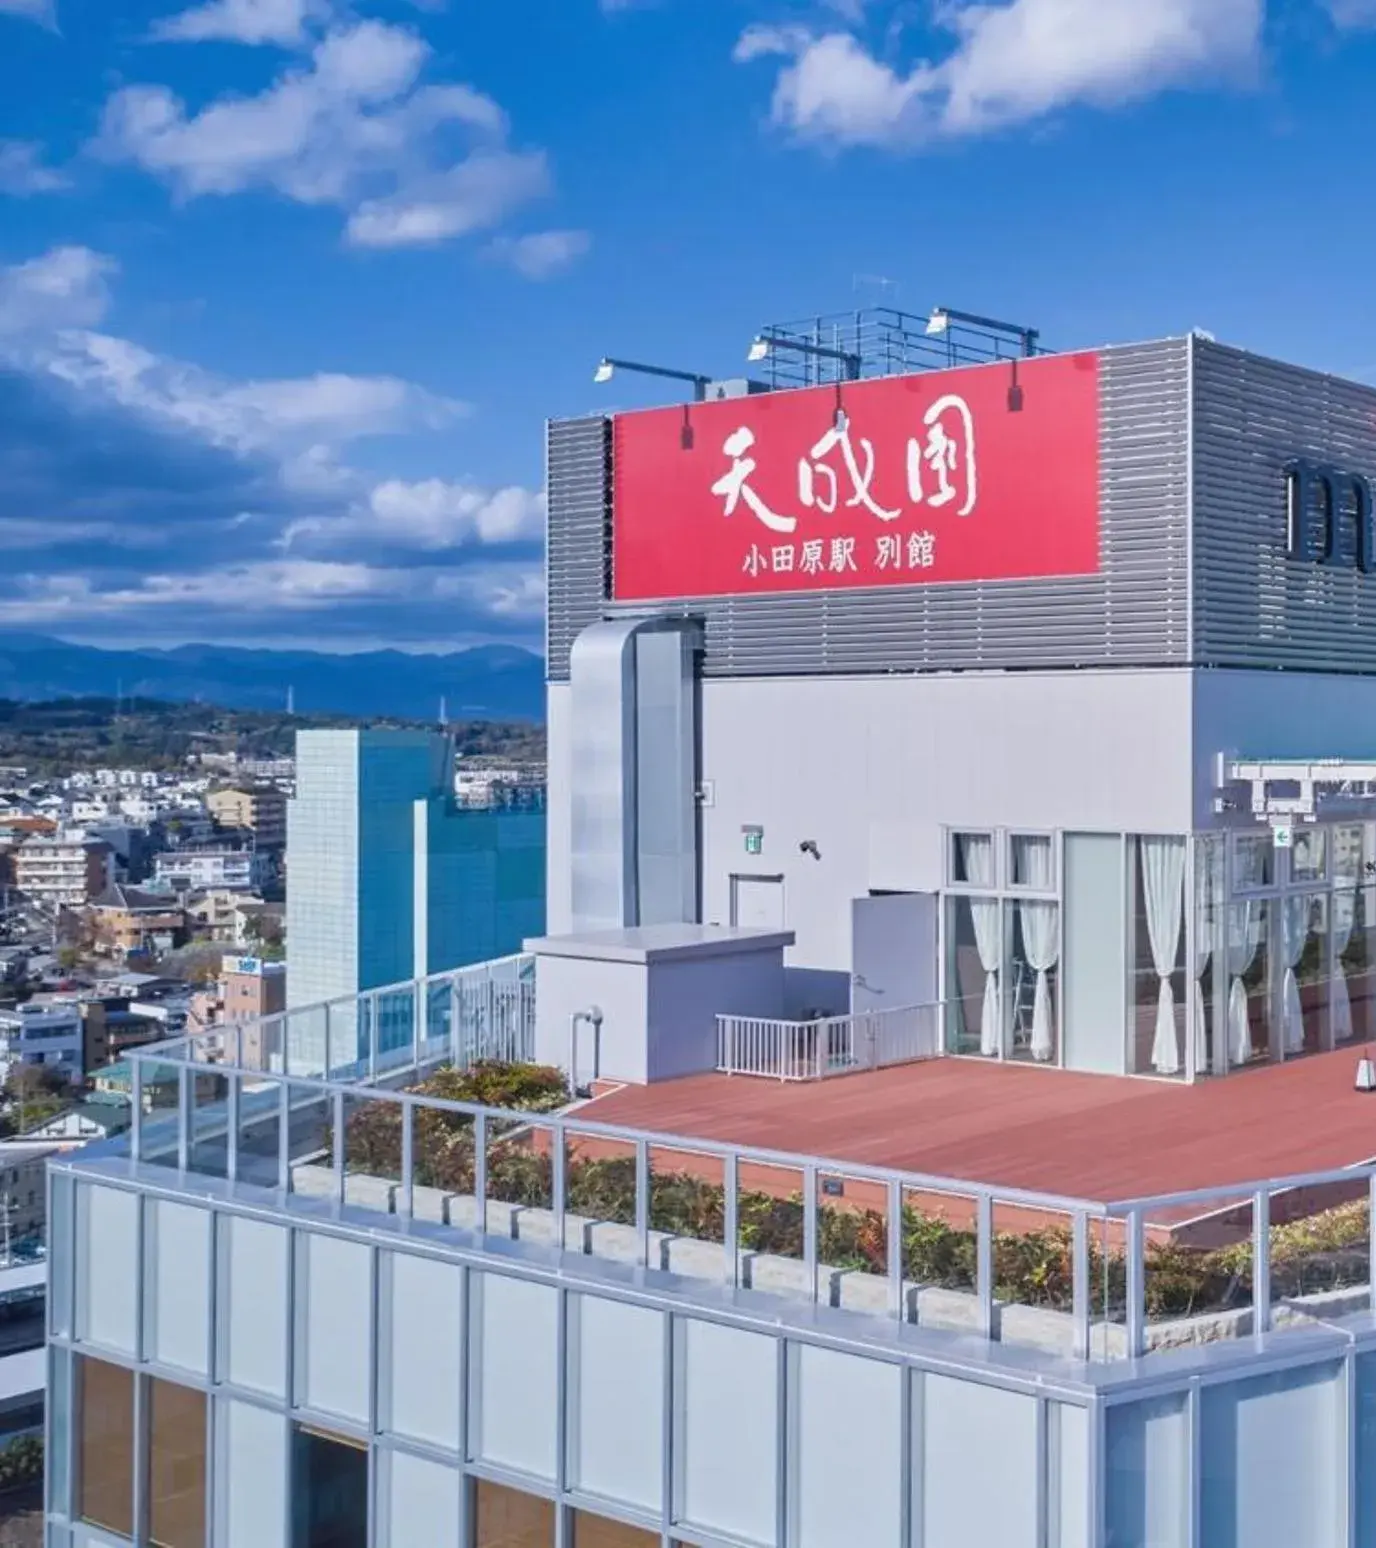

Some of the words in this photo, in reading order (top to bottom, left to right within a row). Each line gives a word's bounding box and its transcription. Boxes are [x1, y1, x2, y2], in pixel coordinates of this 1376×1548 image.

[711, 394, 976, 531] 天成園
[742, 537, 857, 577] 小田原駅
[874, 530, 936, 570] 別館
